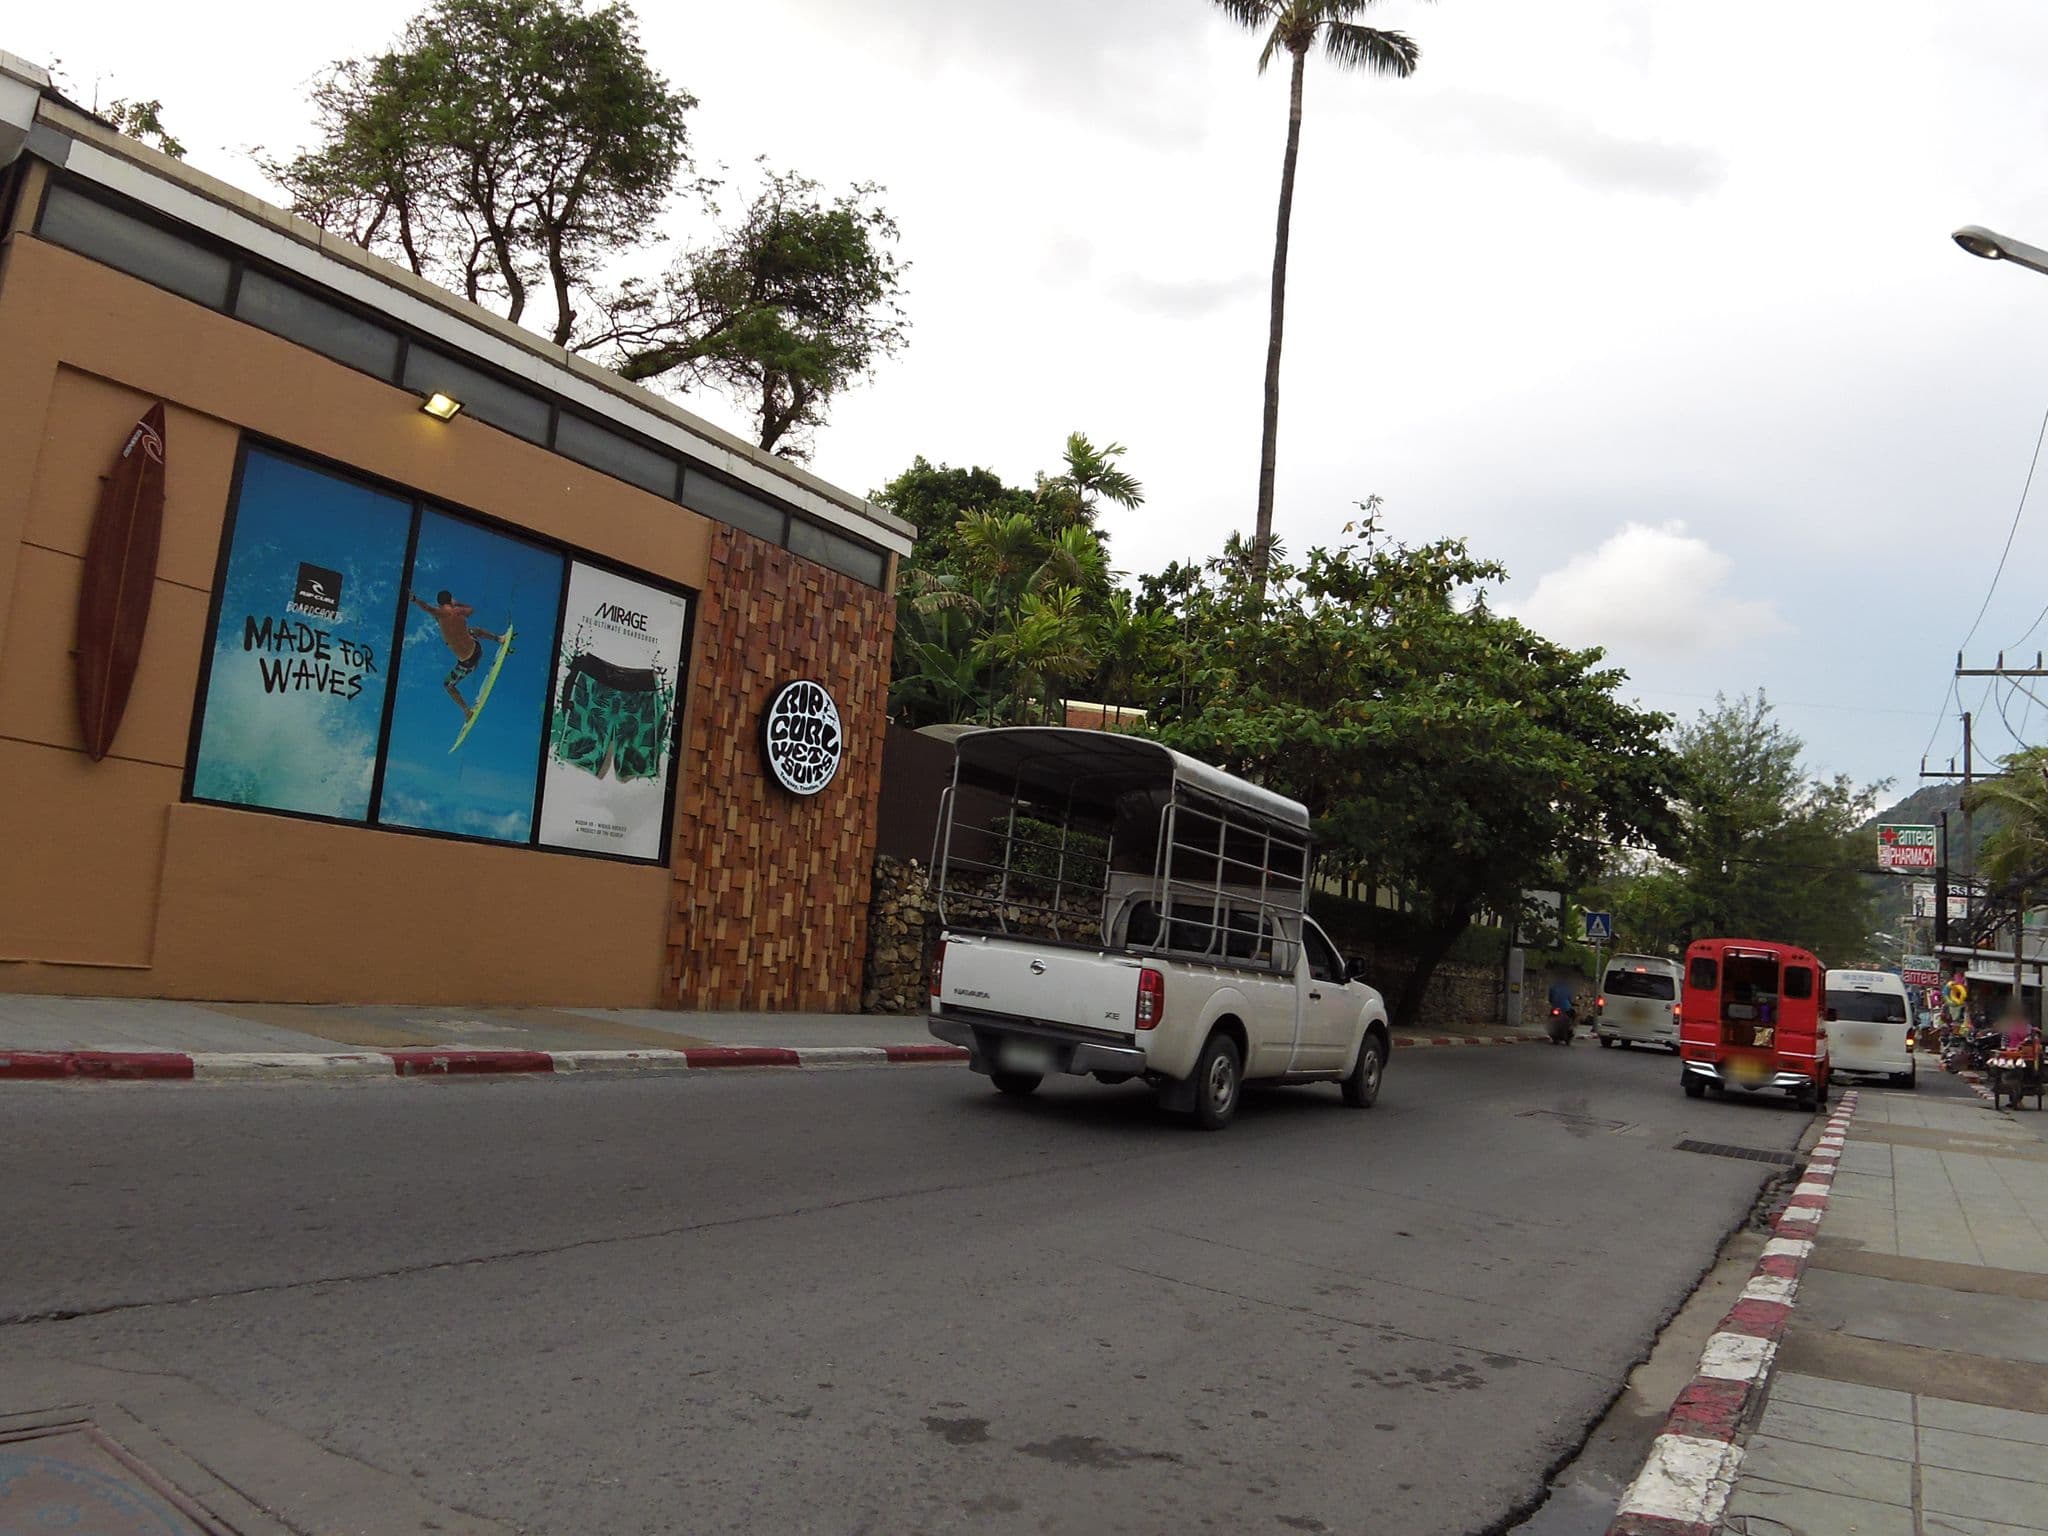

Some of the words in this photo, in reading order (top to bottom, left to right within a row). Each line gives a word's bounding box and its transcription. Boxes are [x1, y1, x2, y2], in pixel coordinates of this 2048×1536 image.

[594, 620, 621, 633] ULTIMATE
[595, 602, 648, 632] MIRAGE
[244, 616, 331, 660] MADE
[338, 638, 378, 674] FOR
[259, 657, 362, 700] WAVES
[776, 683, 823, 716] RIP
[770, 715, 839, 757] CURL
[1899, 830, 1933, 846] аптека
[1890, 847, 1934, 865] PHARMACY
[1904, 971, 1939, 985] аптека
[1104, 1011, 1120, 1021] XE
